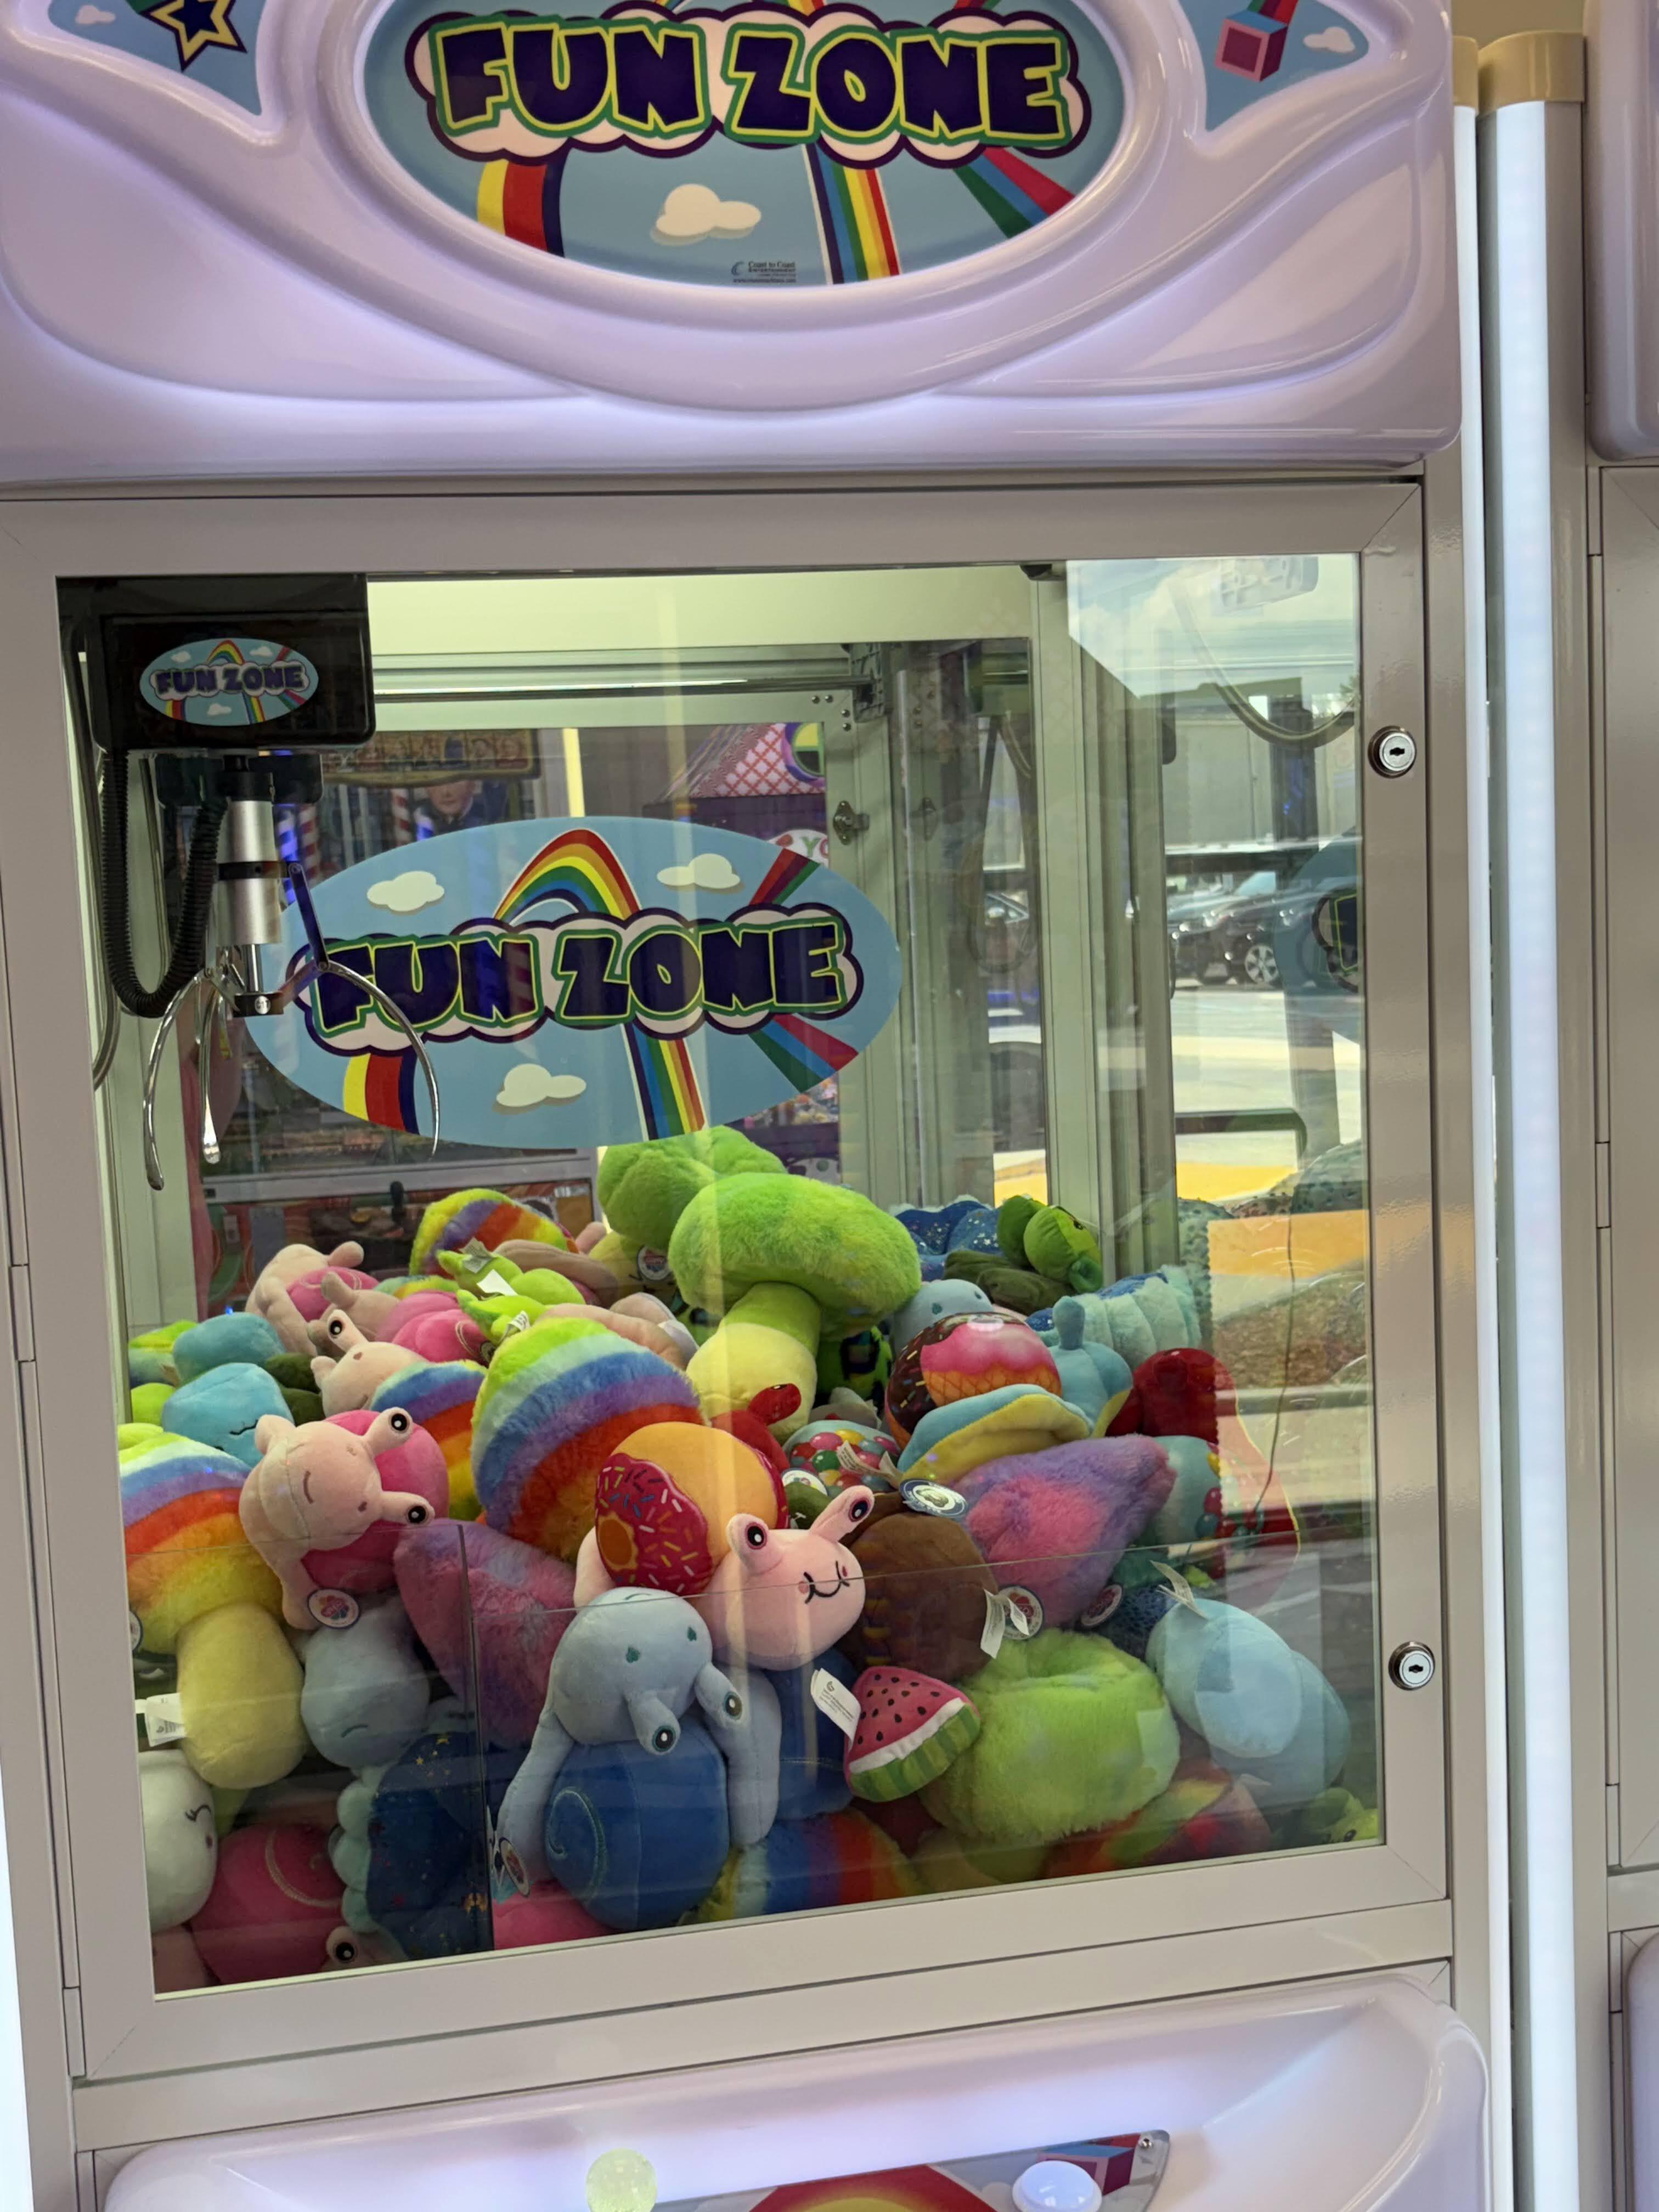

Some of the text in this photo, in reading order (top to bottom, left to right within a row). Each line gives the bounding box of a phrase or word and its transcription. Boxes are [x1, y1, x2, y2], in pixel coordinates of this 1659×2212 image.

[430, 16, 1070, 146] FUN ZONE
[155, 665, 304, 695] FUN ZONE
[311, 919, 845, 1036] FUN ZONE
